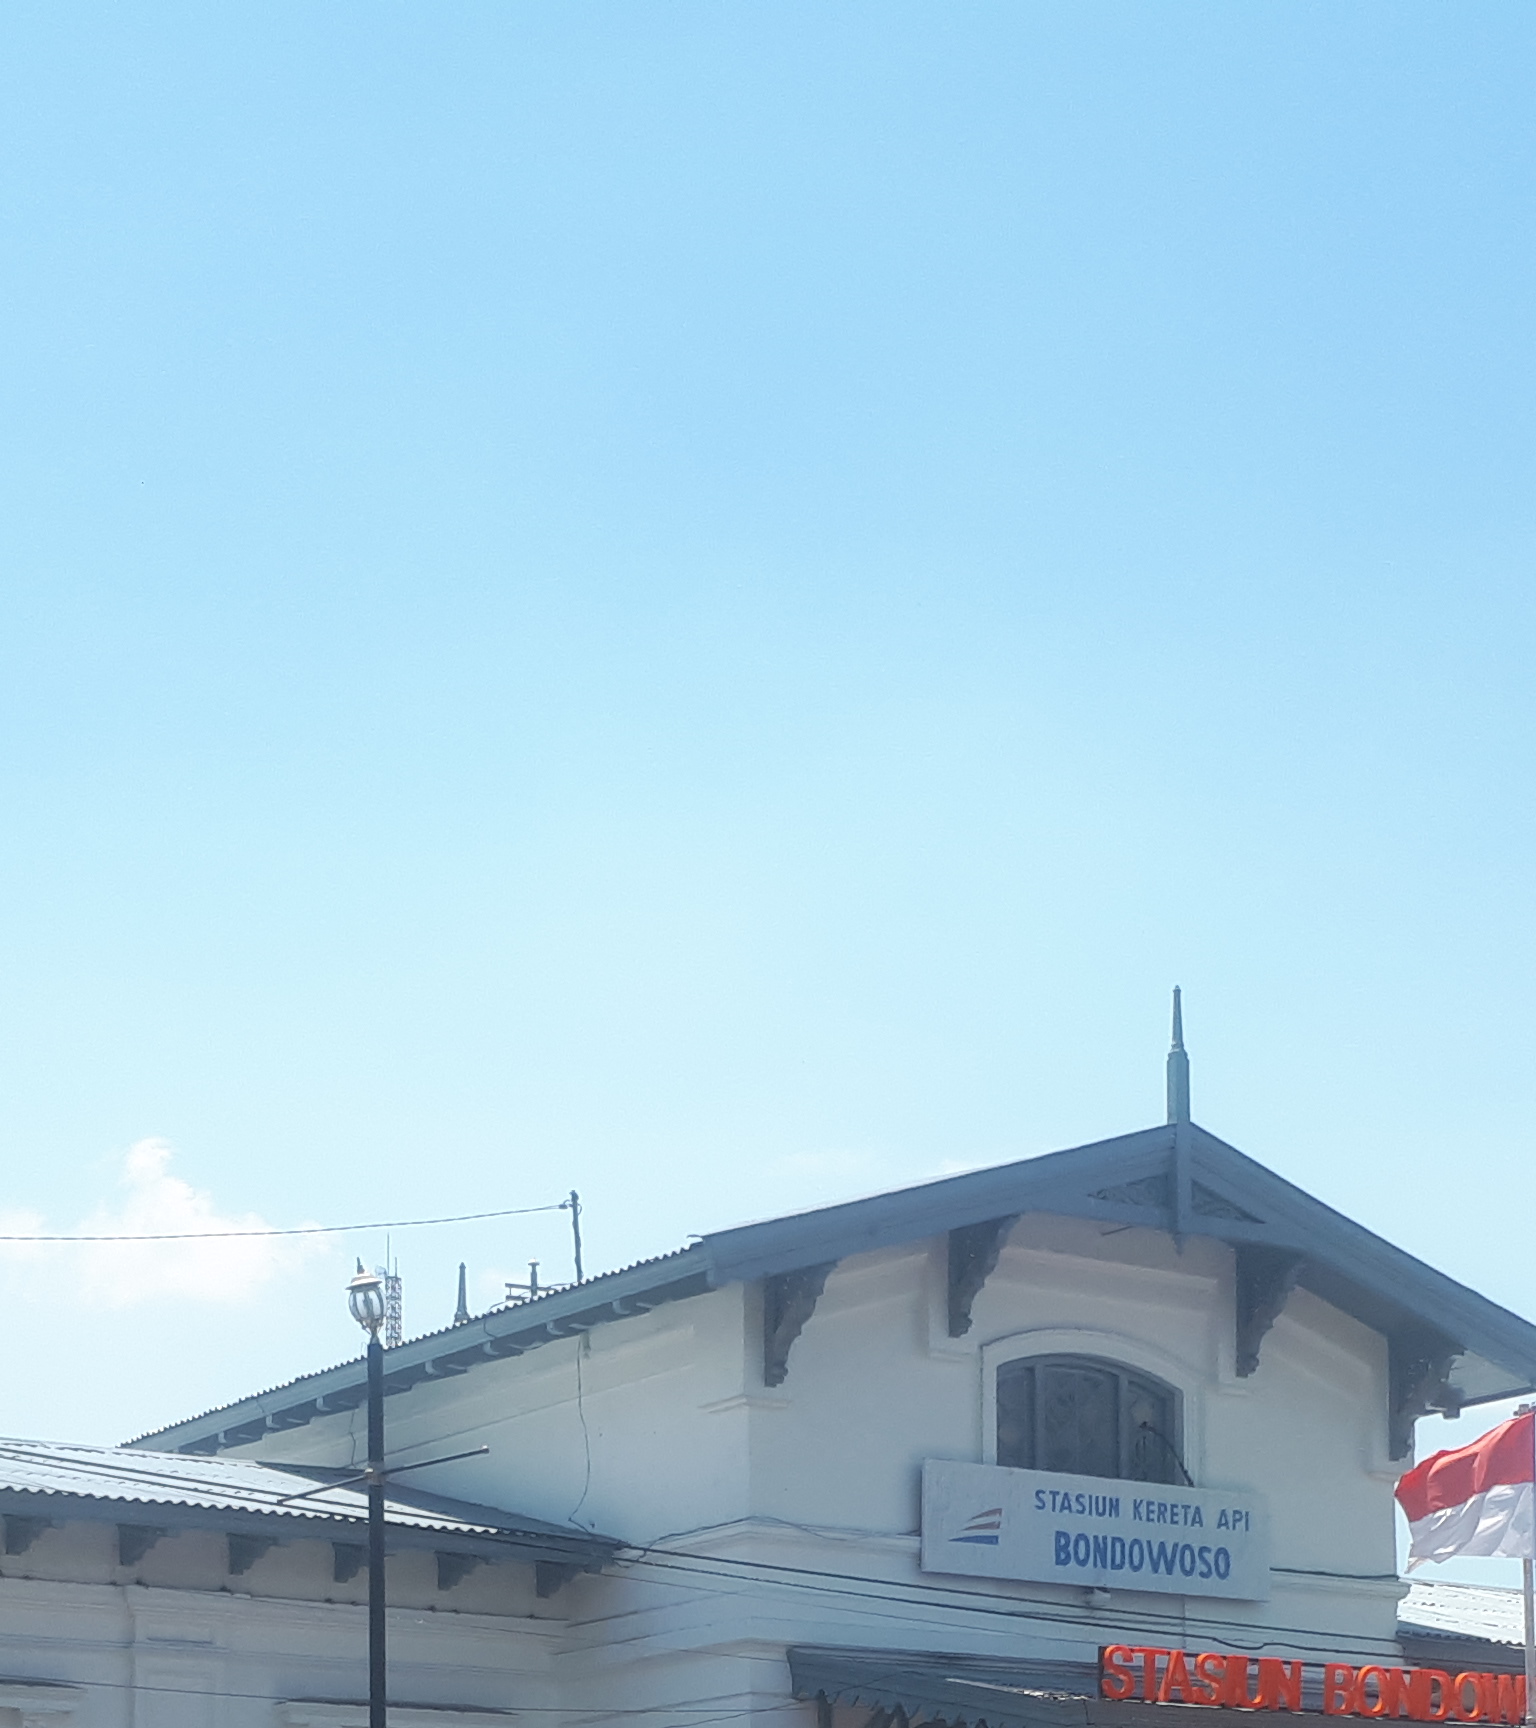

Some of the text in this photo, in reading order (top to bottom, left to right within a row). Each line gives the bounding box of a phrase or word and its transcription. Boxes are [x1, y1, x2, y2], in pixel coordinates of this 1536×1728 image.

[1034, 1489, 1250, 1532] STASIUN KERETA API
[1054, 1530, 1231, 1580] BONDOWOSO
[1101, 1644, 1303, 1713] STASIUN
